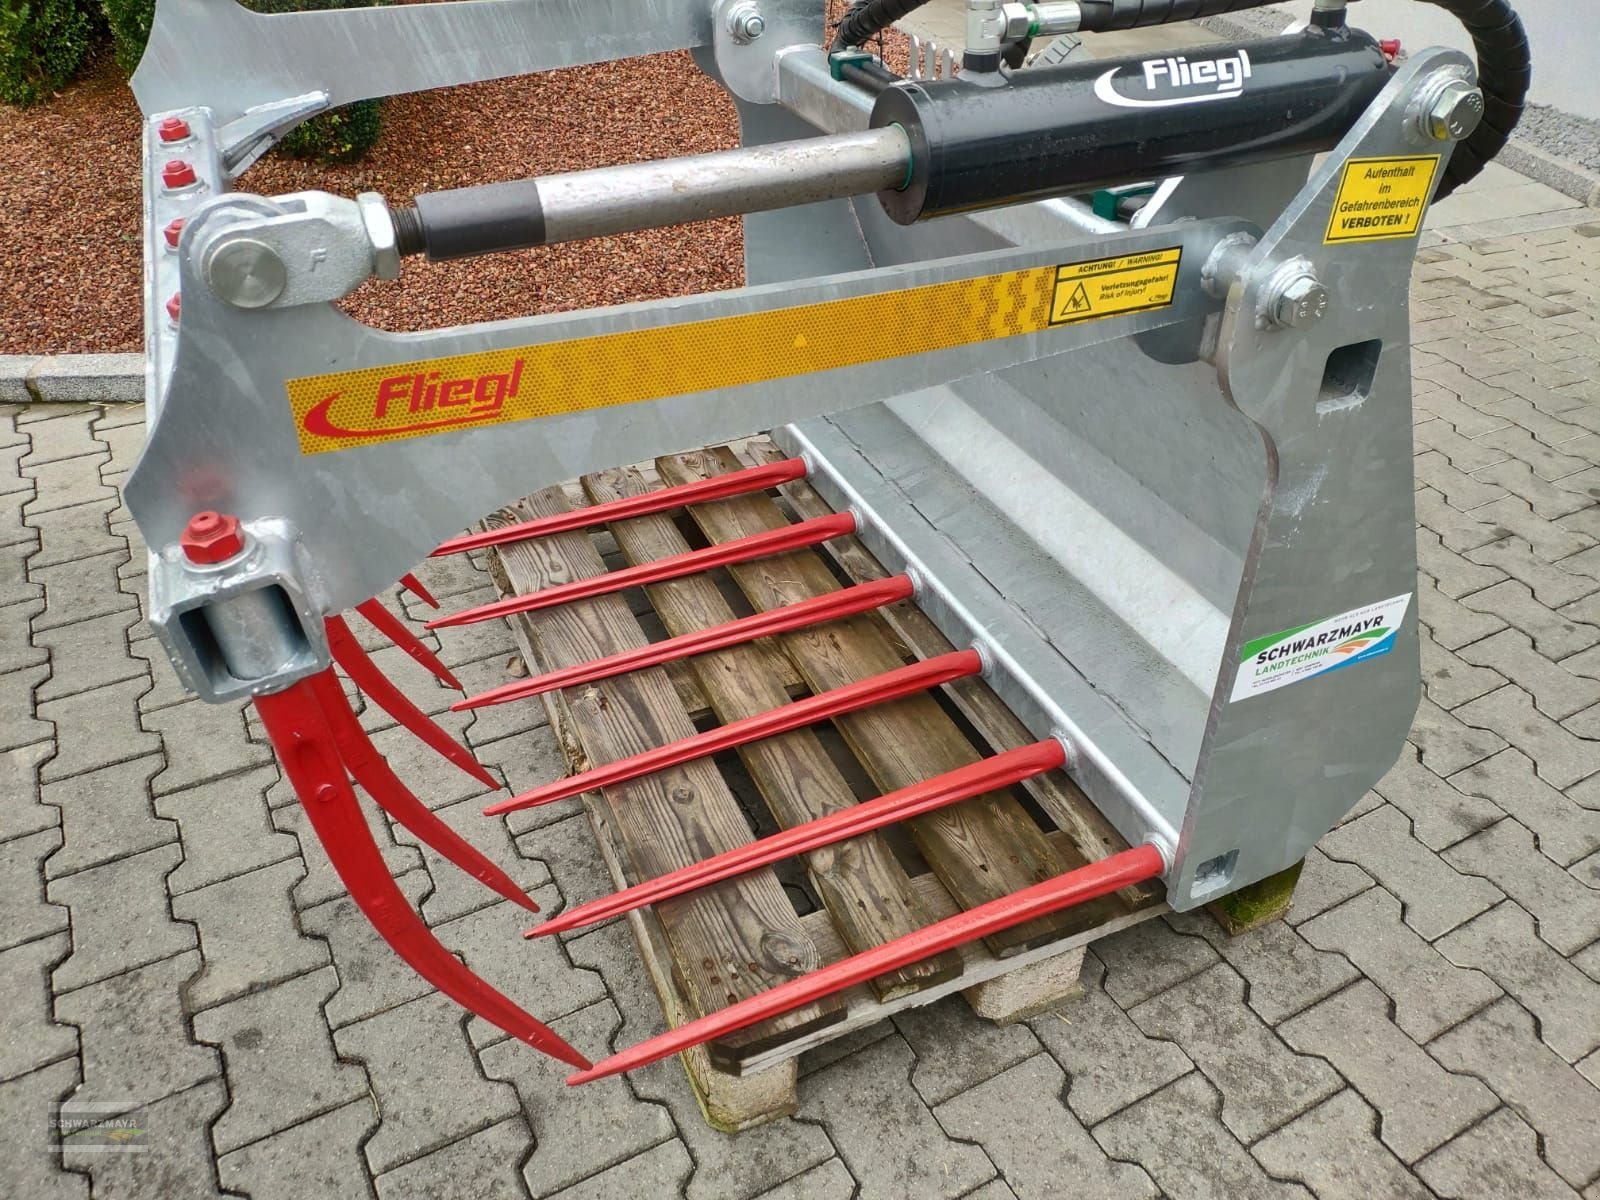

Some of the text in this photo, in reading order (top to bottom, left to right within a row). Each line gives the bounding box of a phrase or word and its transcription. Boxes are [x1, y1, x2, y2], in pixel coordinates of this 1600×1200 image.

[1142, 49, 1252, 91] Fliegl
[1364, 165, 1415, 179] Aufenthalt
[1378, 183, 1392, 194] im
[1340, 196, 1420, 213] Gefahrenbereich
[1341, 215, 1402, 230] VERBOTEN
[1078, 261, 1116, 273] ACHTUNG!
[1127, 253, 1163, 266] WARNING!
[1116, 290, 1125, 299] of
[374, 358, 525, 419] Fliegl
[1256, 615, 1384, 665] SCHWARZMAYR
[1255, 647, 1331, 676] LANDTECHNIK
